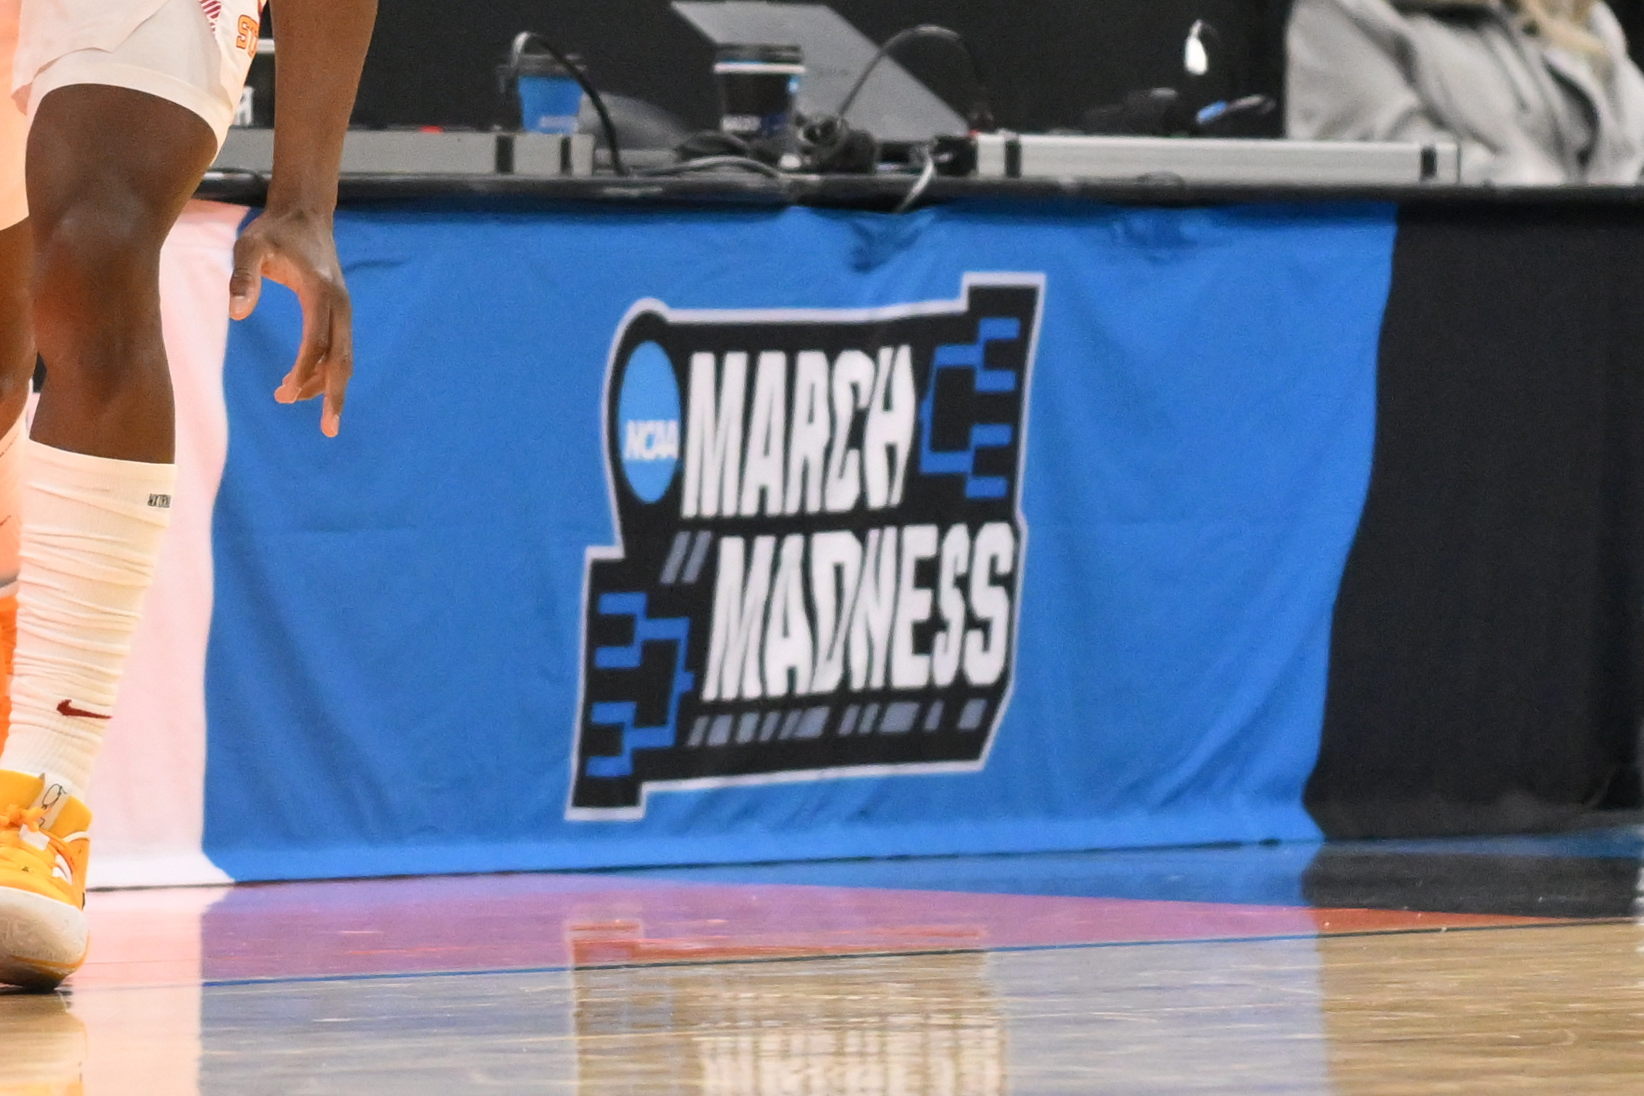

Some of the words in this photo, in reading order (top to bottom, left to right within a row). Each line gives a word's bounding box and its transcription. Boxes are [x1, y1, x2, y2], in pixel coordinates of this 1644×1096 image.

[625, 418, 679, 461] NCAA
[681, 344, 916, 520] MARCH
[702, 522, 1016, 702] MADNESS
